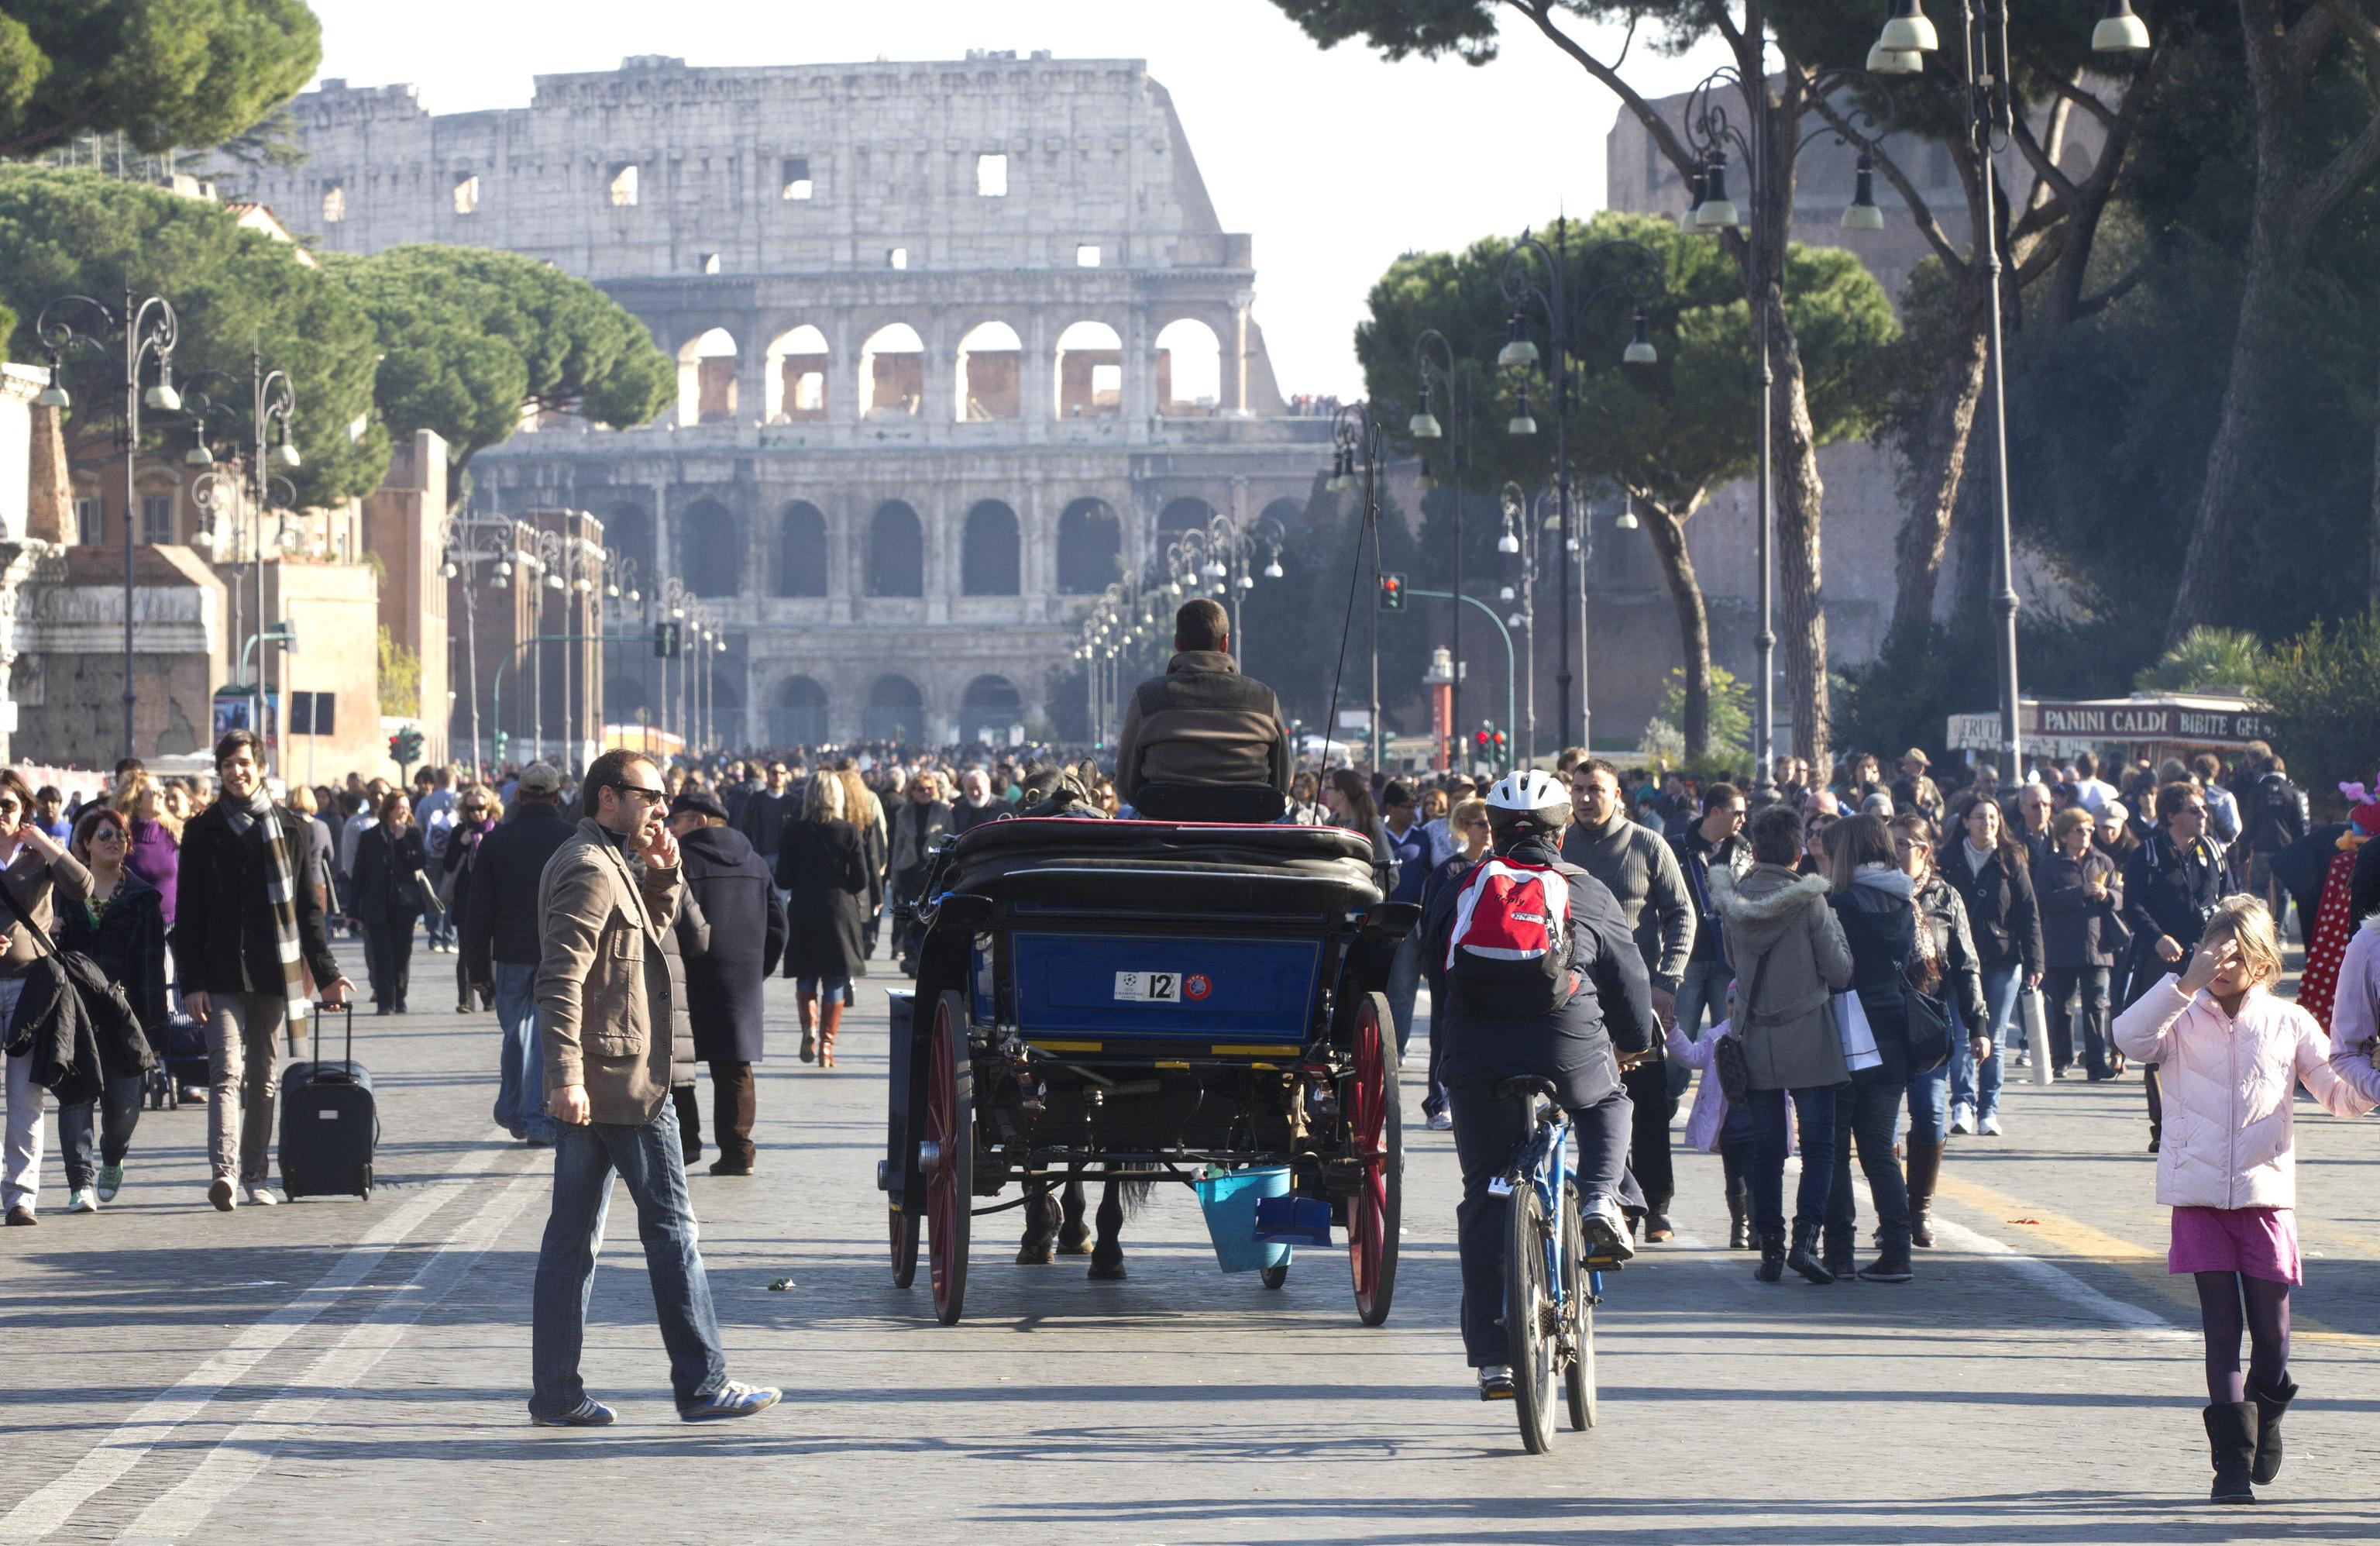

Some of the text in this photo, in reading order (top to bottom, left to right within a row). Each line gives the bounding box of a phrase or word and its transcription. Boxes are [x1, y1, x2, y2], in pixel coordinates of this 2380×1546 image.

[2045, 710, 2106, 732] PANINI
[2111, 711, 2168, 732] CALDI
[2179, 712, 2228, 735] BIBITE
[1150, 974, 1171, 998] 12
[1187, 975, 1204, 983] UEFA
